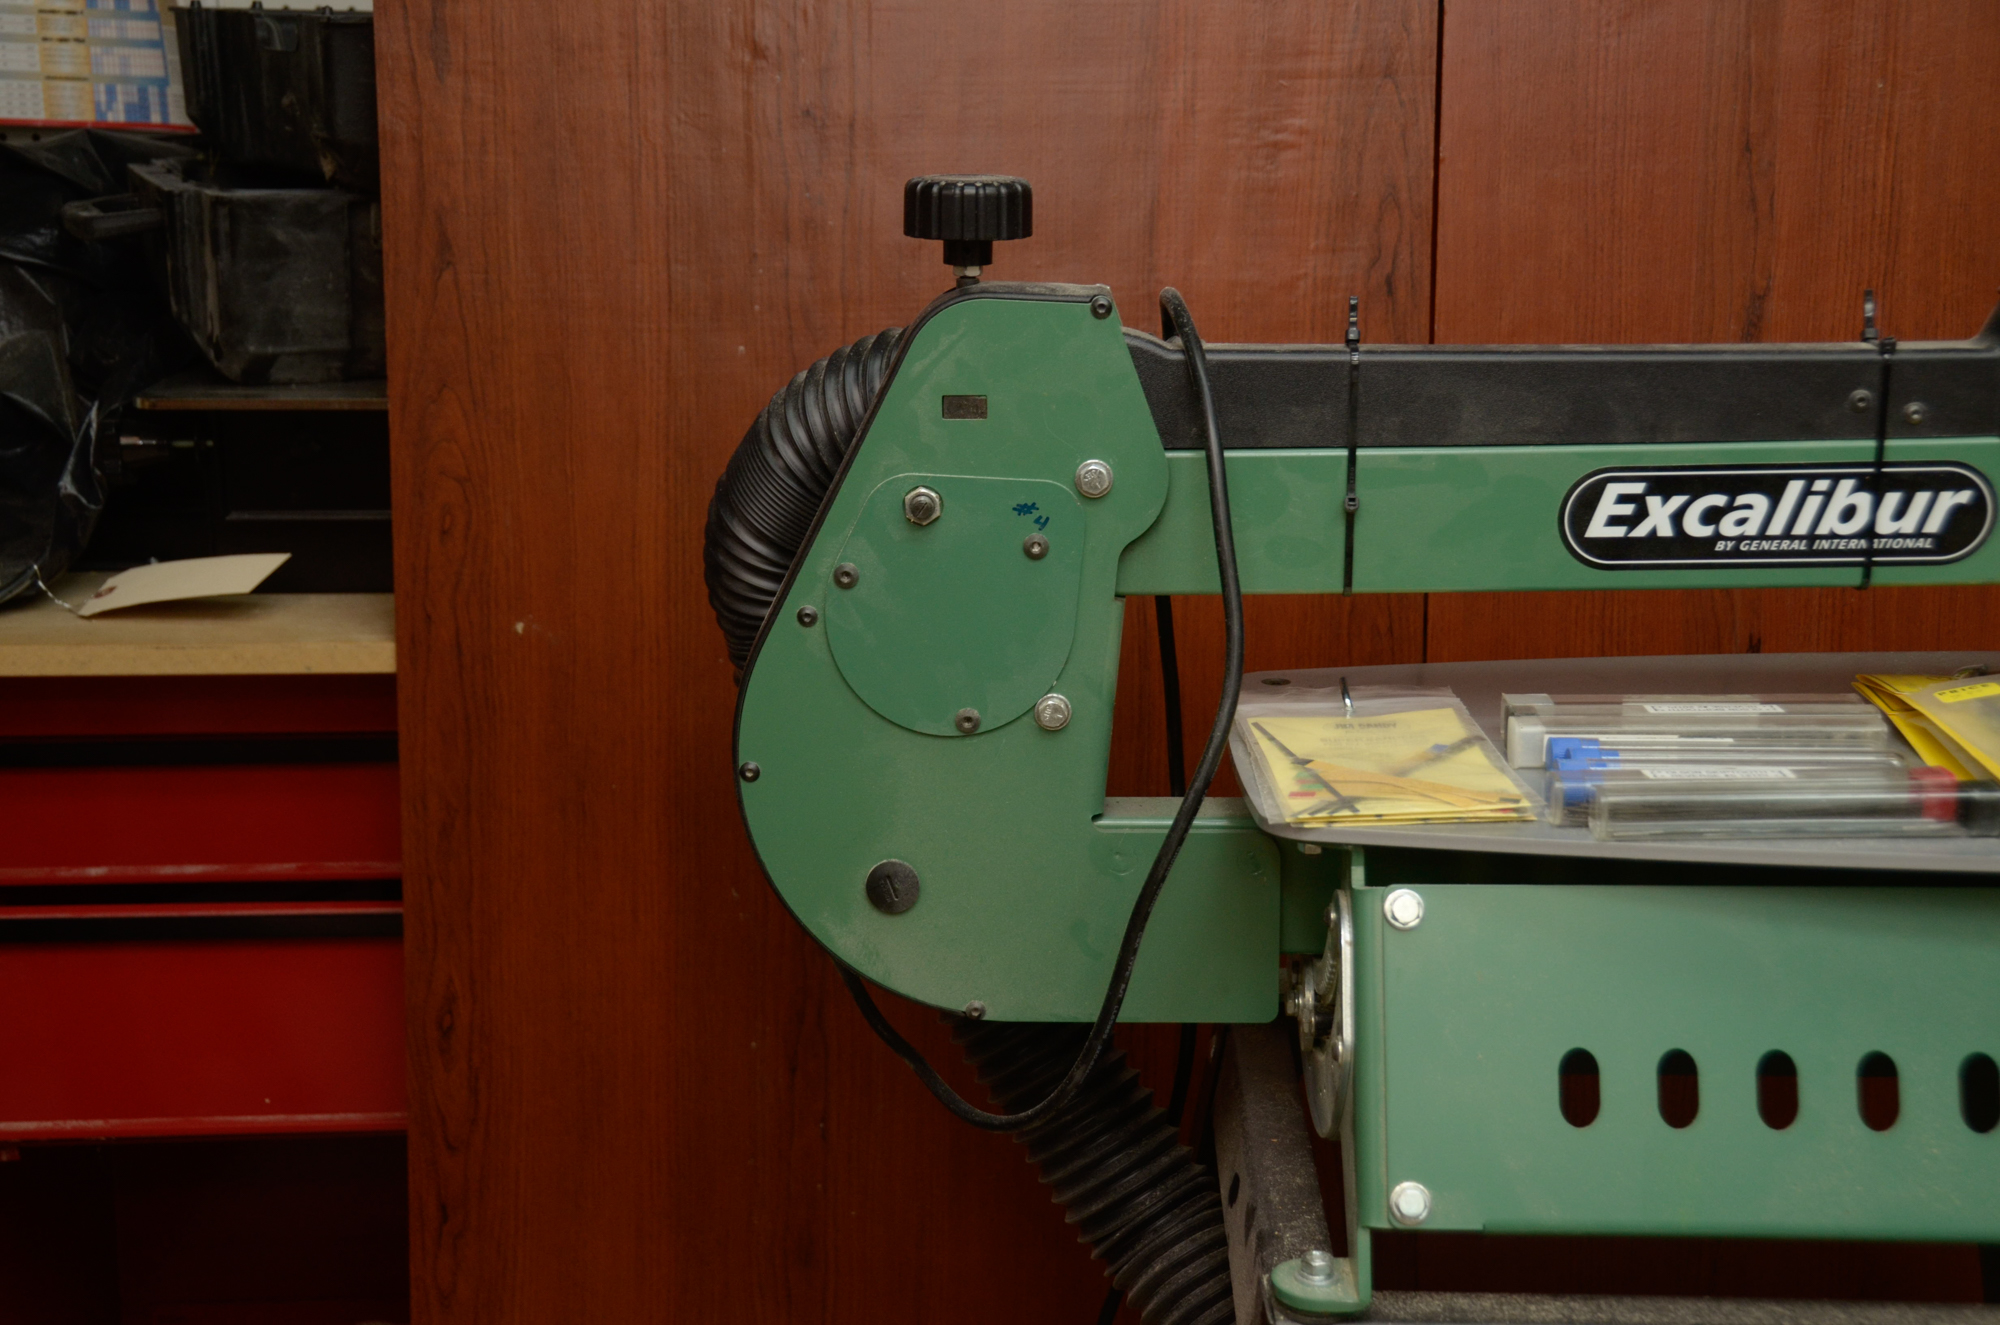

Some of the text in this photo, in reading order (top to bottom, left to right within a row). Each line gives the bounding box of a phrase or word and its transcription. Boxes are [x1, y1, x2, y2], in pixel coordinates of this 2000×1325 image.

[1584, 478, 1974, 538] Excalibur
[1714, 540, 1736, 551] BY
[1739, 539, 1808, 551] GENERAL
